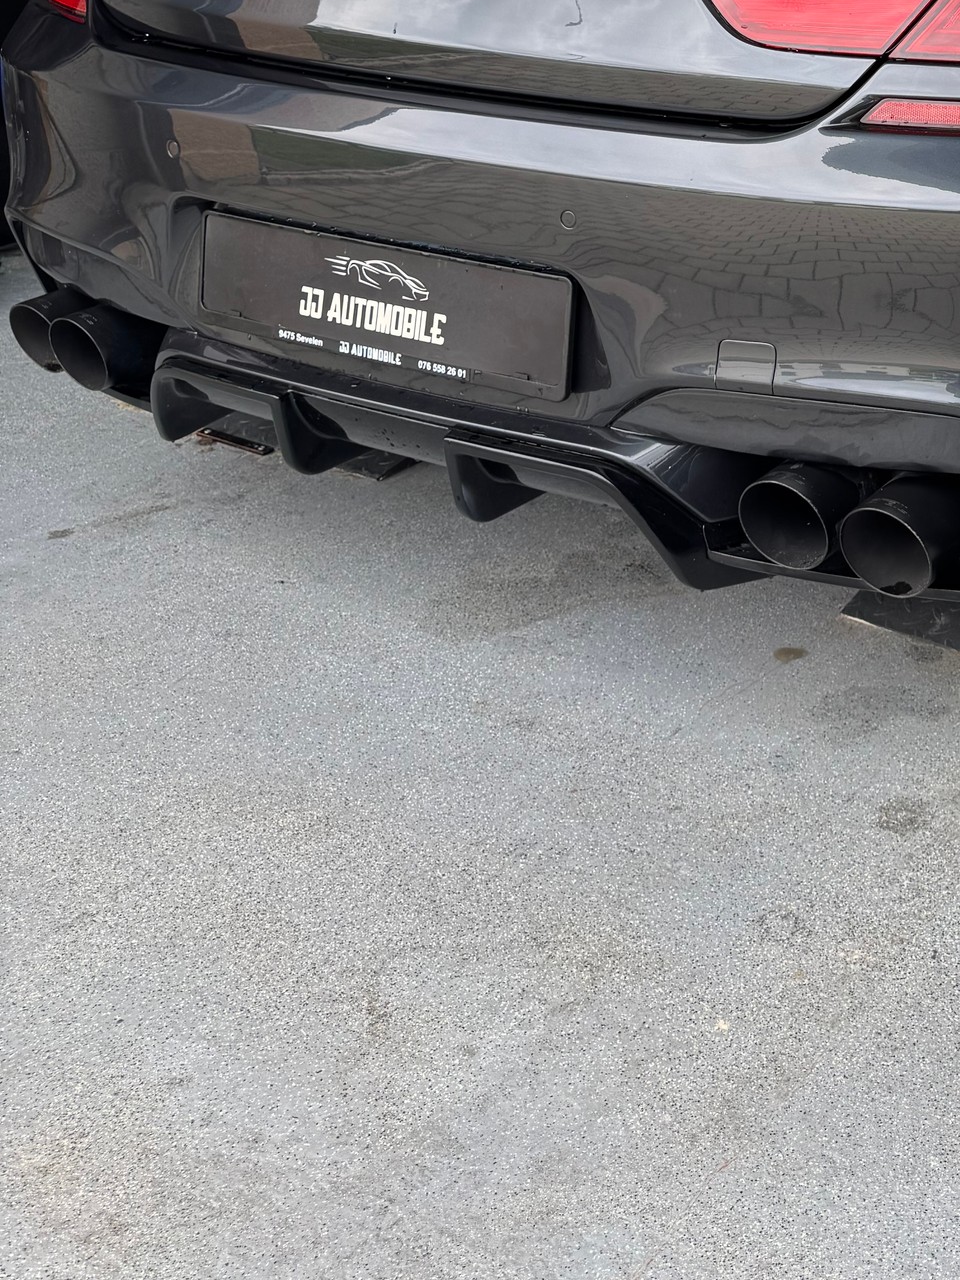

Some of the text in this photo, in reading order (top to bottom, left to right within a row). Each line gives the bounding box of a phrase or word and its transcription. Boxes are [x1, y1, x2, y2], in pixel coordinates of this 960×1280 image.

[299, 285, 447, 346] JJ AUTOMOBILE
[278, 329, 296, 341] 9475
[339, 340, 402, 366] JJ AUTOMOBILE
[417, 359, 467, 379] 076 558 26 01
